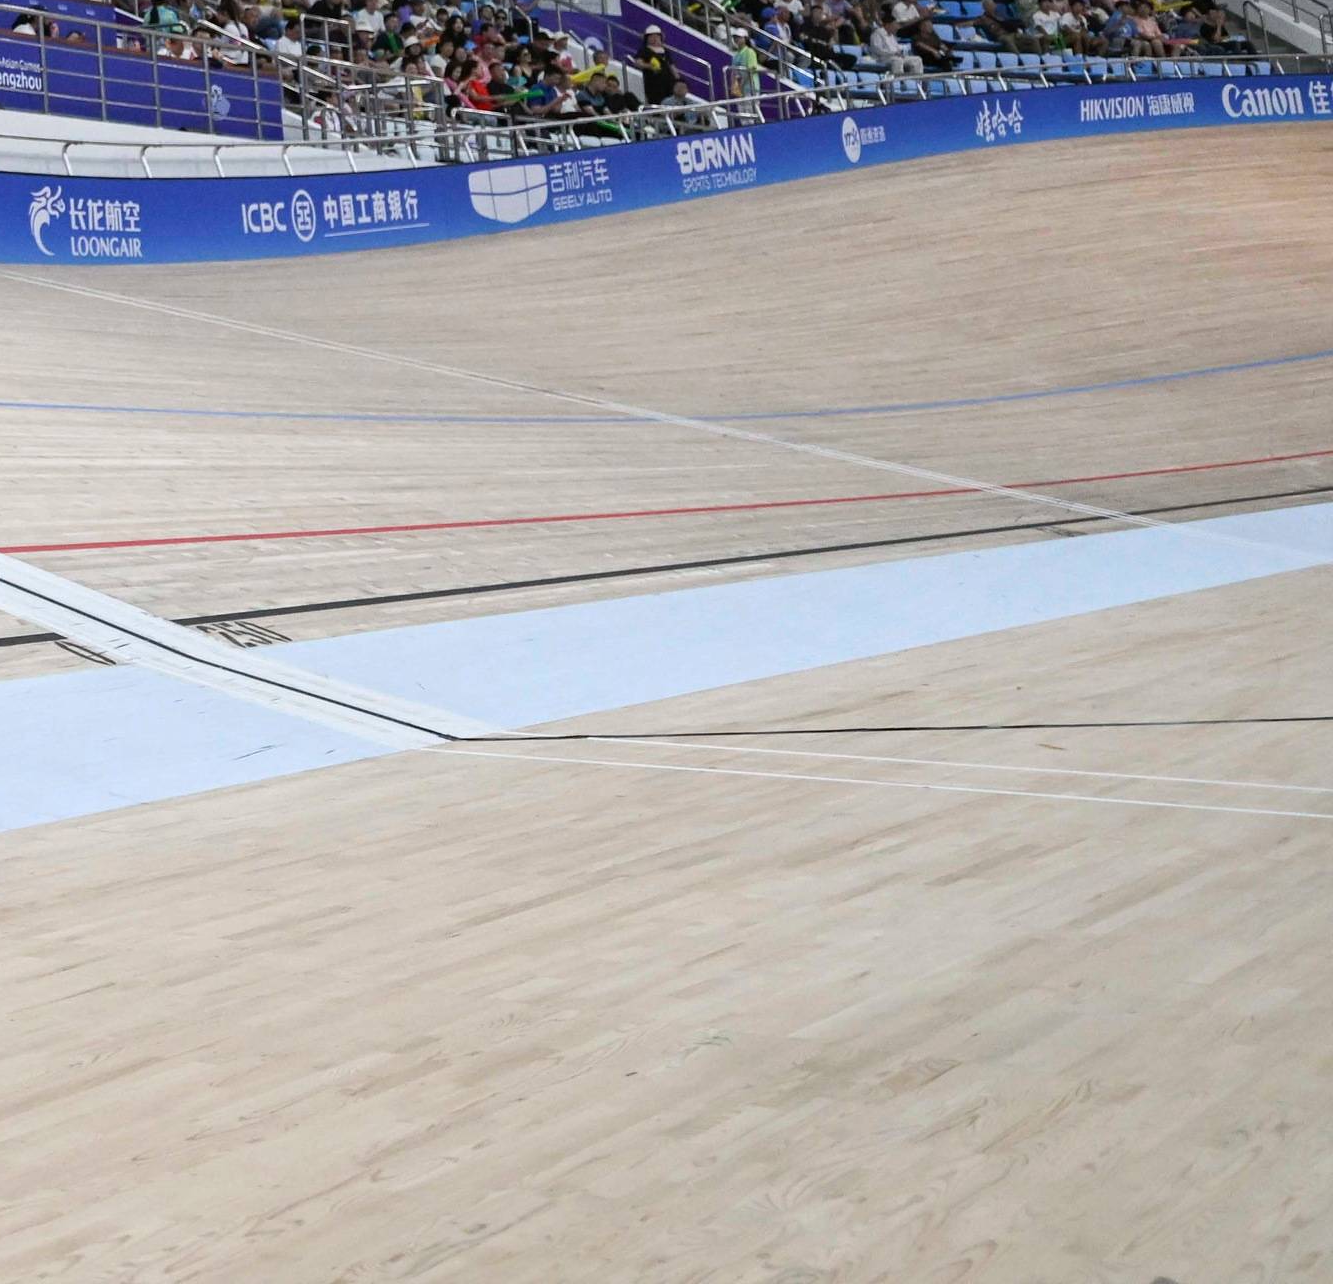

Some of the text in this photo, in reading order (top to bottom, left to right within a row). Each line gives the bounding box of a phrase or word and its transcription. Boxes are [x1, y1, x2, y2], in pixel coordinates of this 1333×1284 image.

[1080, 95, 1144, 122] HIKVISION
[1221, 80, 1333, 118] Canon 佳
[676, 132, 756, 175] BORNAN
[548, 158, 610, 193] 吉利汽车
[69, 198, 142, 232] 长龙航空
[241, 189, 419, 234] ICBC 中国工商银行
[553, 188, 613, 211] GEELY AUTO
[70, 236, 143, 257] LOONGAIR
